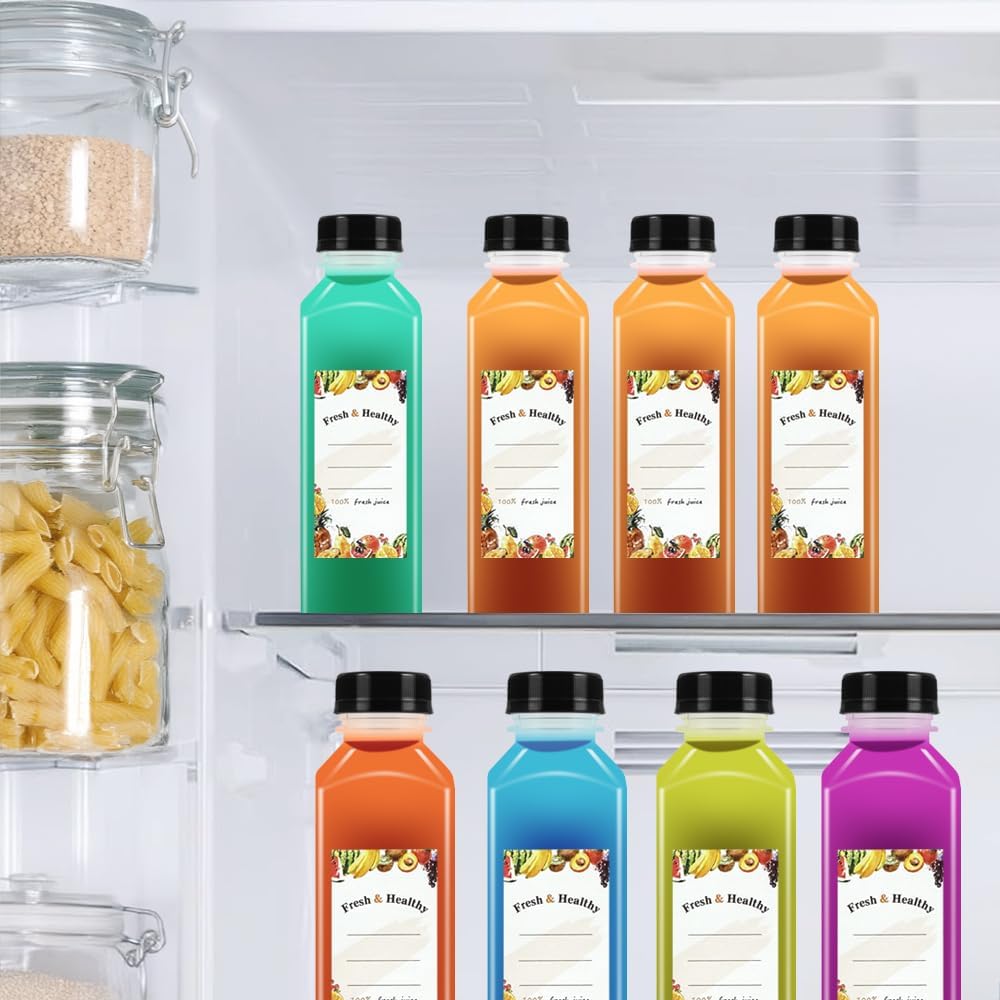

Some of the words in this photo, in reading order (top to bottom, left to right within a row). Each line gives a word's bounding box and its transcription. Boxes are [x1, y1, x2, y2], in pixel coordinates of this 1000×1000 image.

[322, 409, 349, 426] Fresh
[351, 409, 360, 418] &
[362, 408, 400, 427] Healthy
[489, 409, 516, 426] Fresh
[518, 409, 527, 418] &
[529, 408, 567, 427] Healthy
[635, 409, 662, 426] Fresh
[664, 409, 673, 418] &
[675, 408, 713, 427] Healthy
[779, 409, 806, 426] Fresh
[808, 409, 817, 418] &
[819, 408, 857, 427] Healthy
[353, 497, 372, 506] fresh
[373, 498, 390, 506] juice
[520, 497, 539, 506] fresh
[540, 498, 557, 506] juice
[666, 497, 685, 506] fresh
[686, 498, 703, 506] juice
[810, 497, 829, 506] fresh
[830, 498, 847, 506] juice
[341, 895, 372, 914] Fresh
[373, 894, 384, 904] &
[386, 893, 429, 915] Healthy
[513, 895, 544, 914] Fresh
[545, 894, 556, 904] &
[558, 893, 601, 915] Healthy
[682, 895, 713, 914] Fresh
[714, 894, 725, 904] &
[727, 893, 770, 915] Healthy
[847, 895, 878, 914] Fresh
[879, 894, 890, 904] &
[892, 893, 935, 915] Healthy
